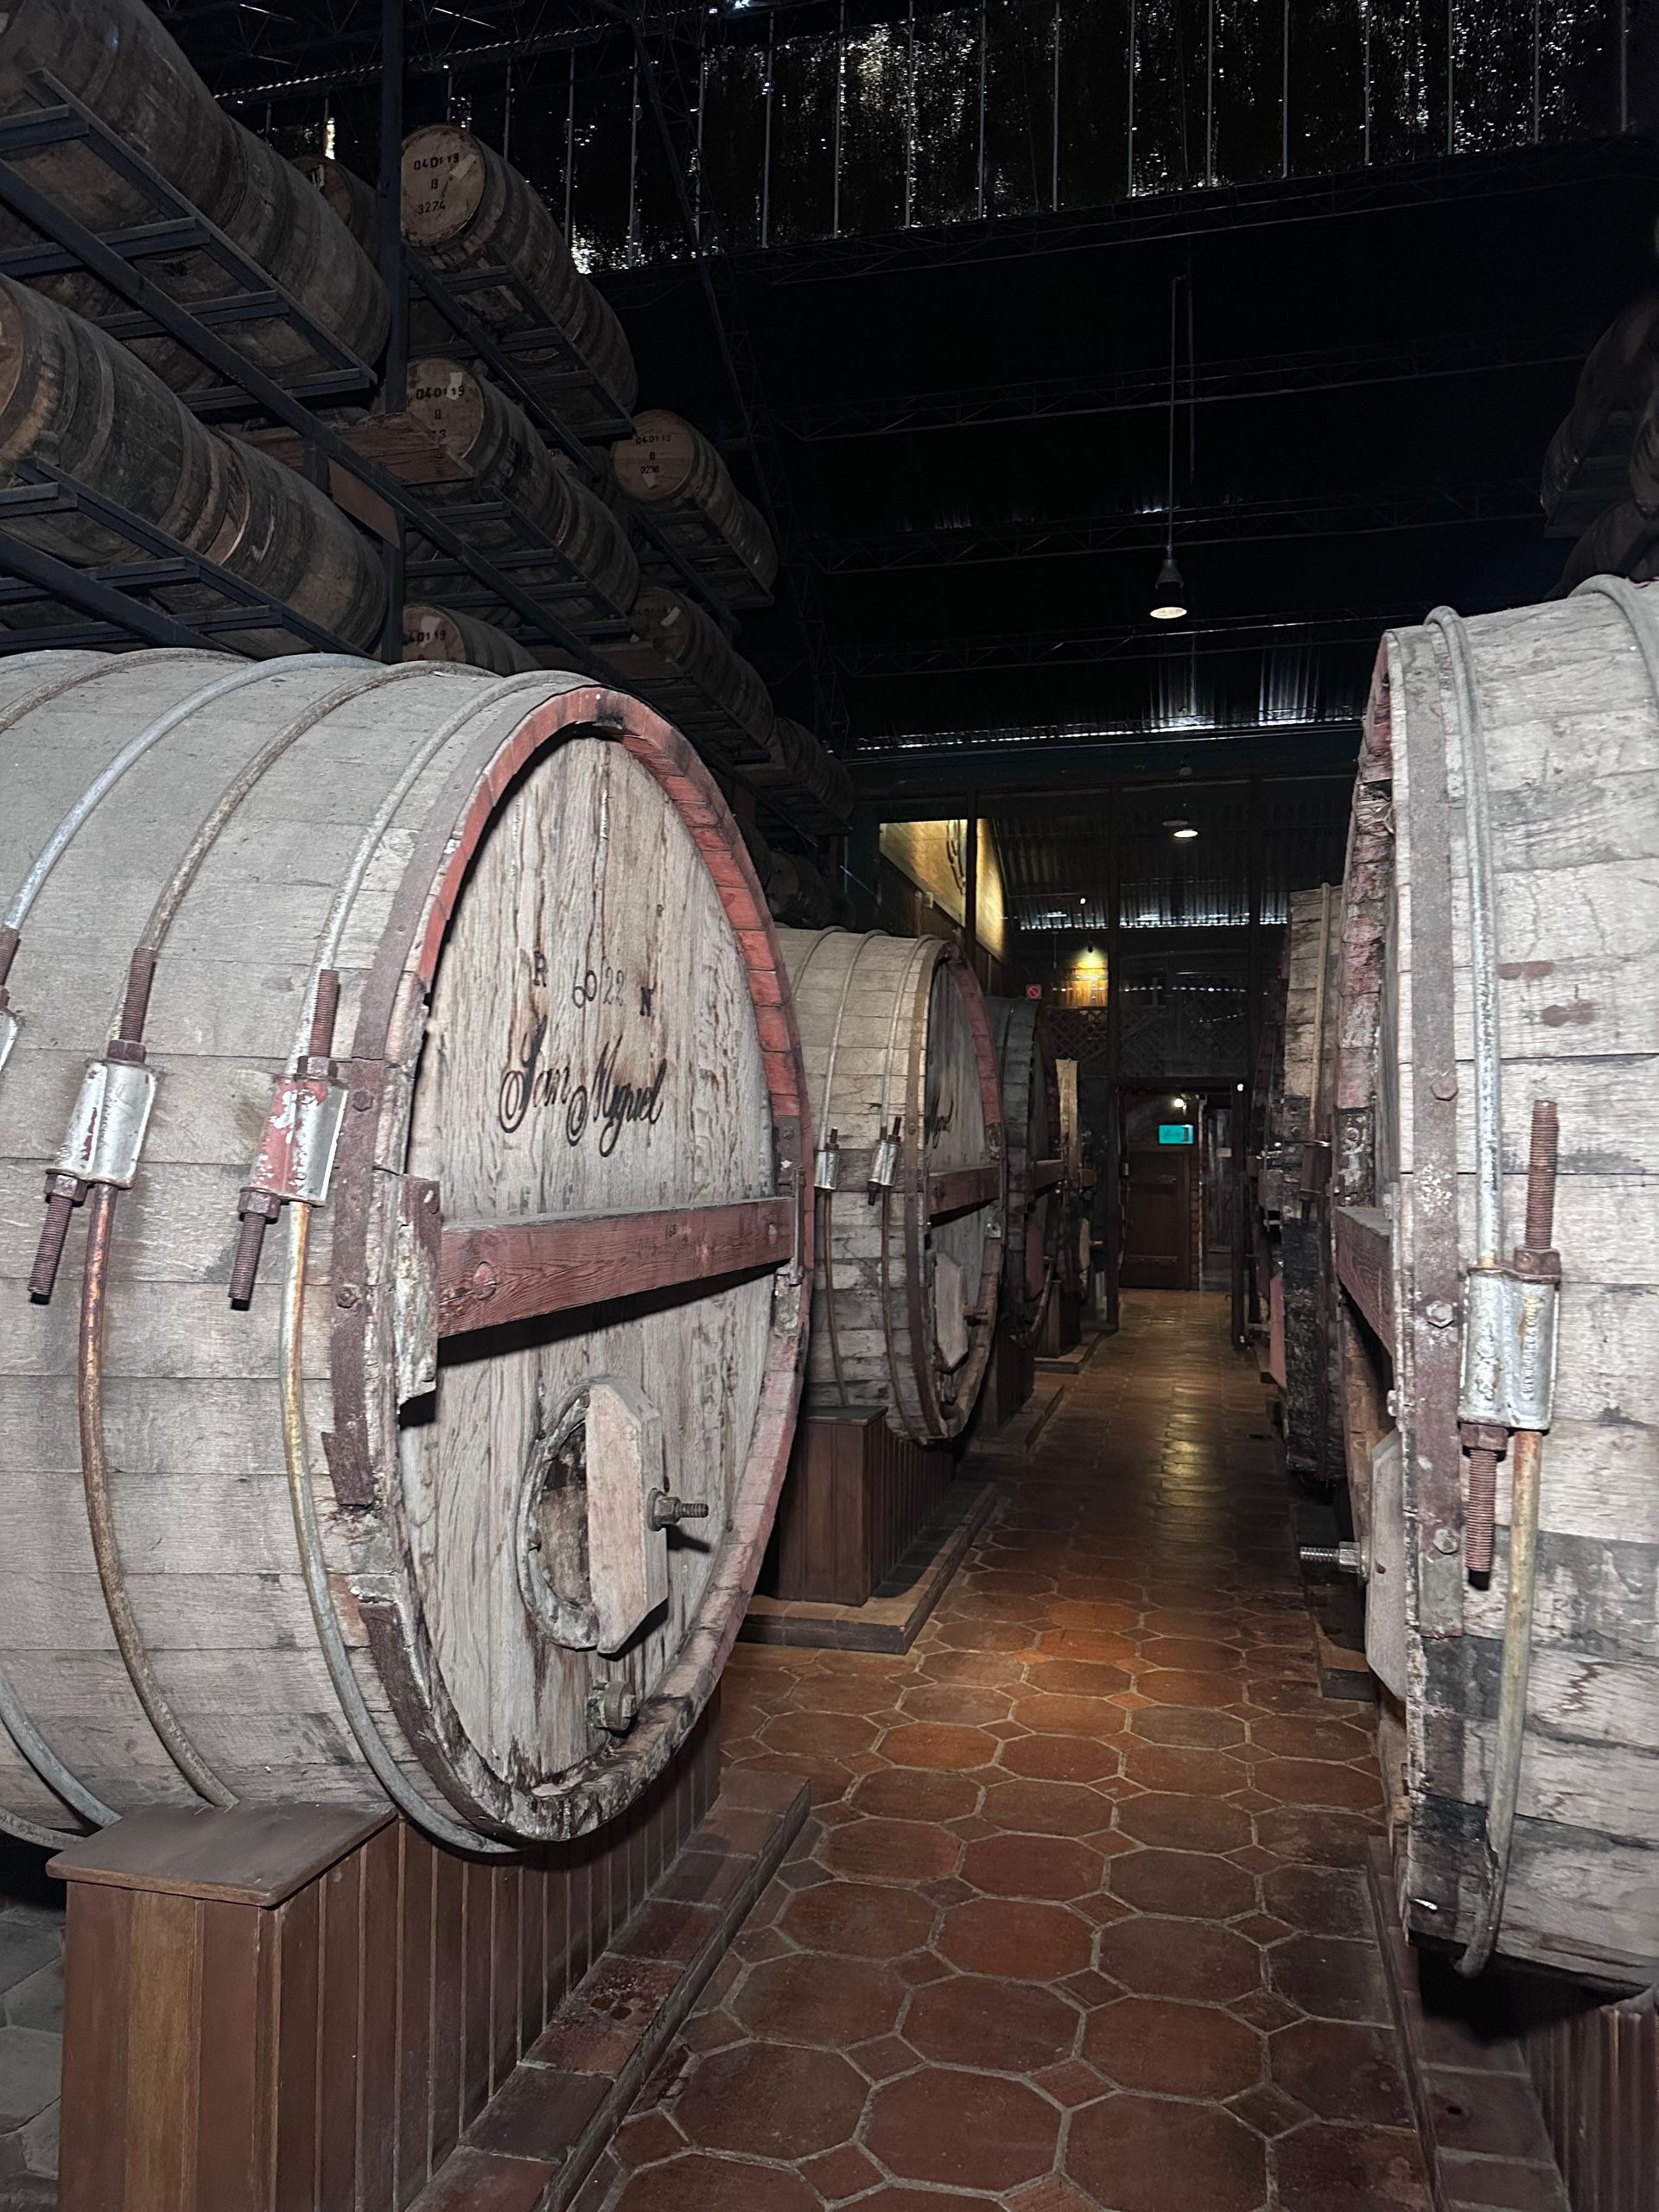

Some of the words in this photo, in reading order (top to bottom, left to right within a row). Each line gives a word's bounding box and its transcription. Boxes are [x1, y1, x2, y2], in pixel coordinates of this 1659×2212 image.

[414, 153, 459, 170] 040119
[431, 178, 438, 189] B
[417, 200, 446, 215] 3274
[416, 385, 465, 400] 040119
[635, 434, 671, 445] 040119
[533, 951, 547, 988] R
[499, 1014, 570, 1134] San
